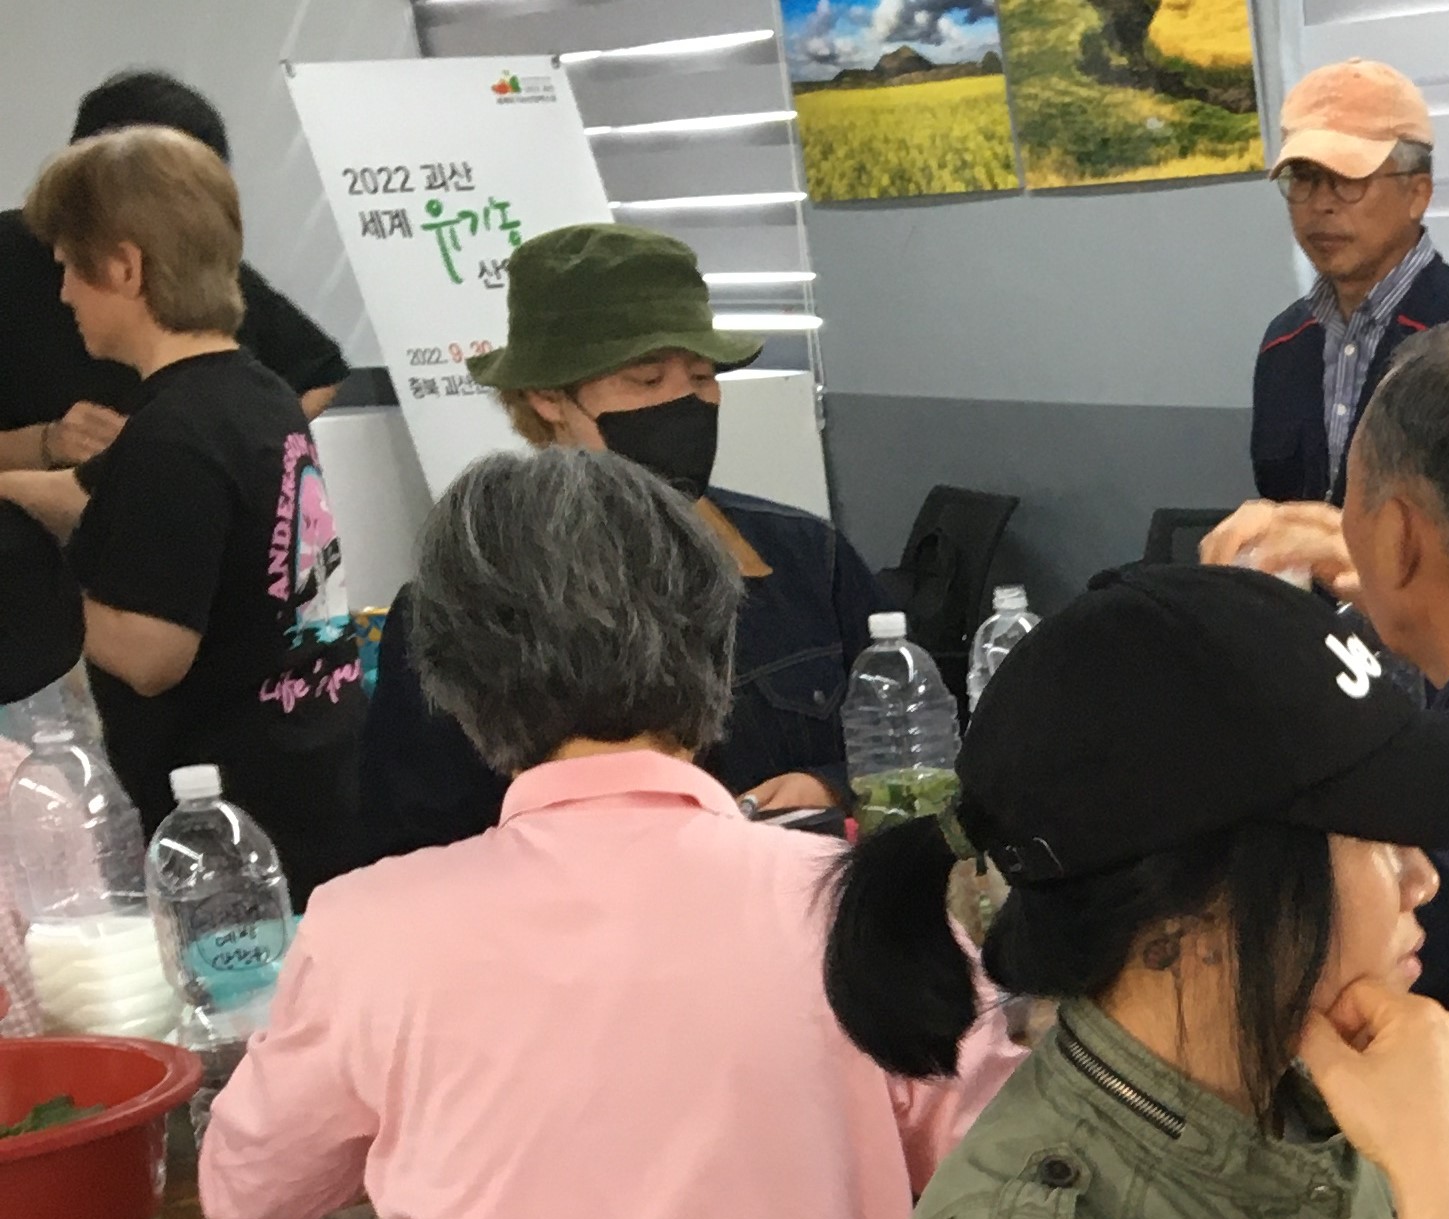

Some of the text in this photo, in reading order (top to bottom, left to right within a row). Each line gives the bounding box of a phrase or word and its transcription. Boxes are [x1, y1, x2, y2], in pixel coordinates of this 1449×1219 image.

[342, 160, 475, 195] 2022 괴산
[359, 196, 522, 285] 세계 유기농
